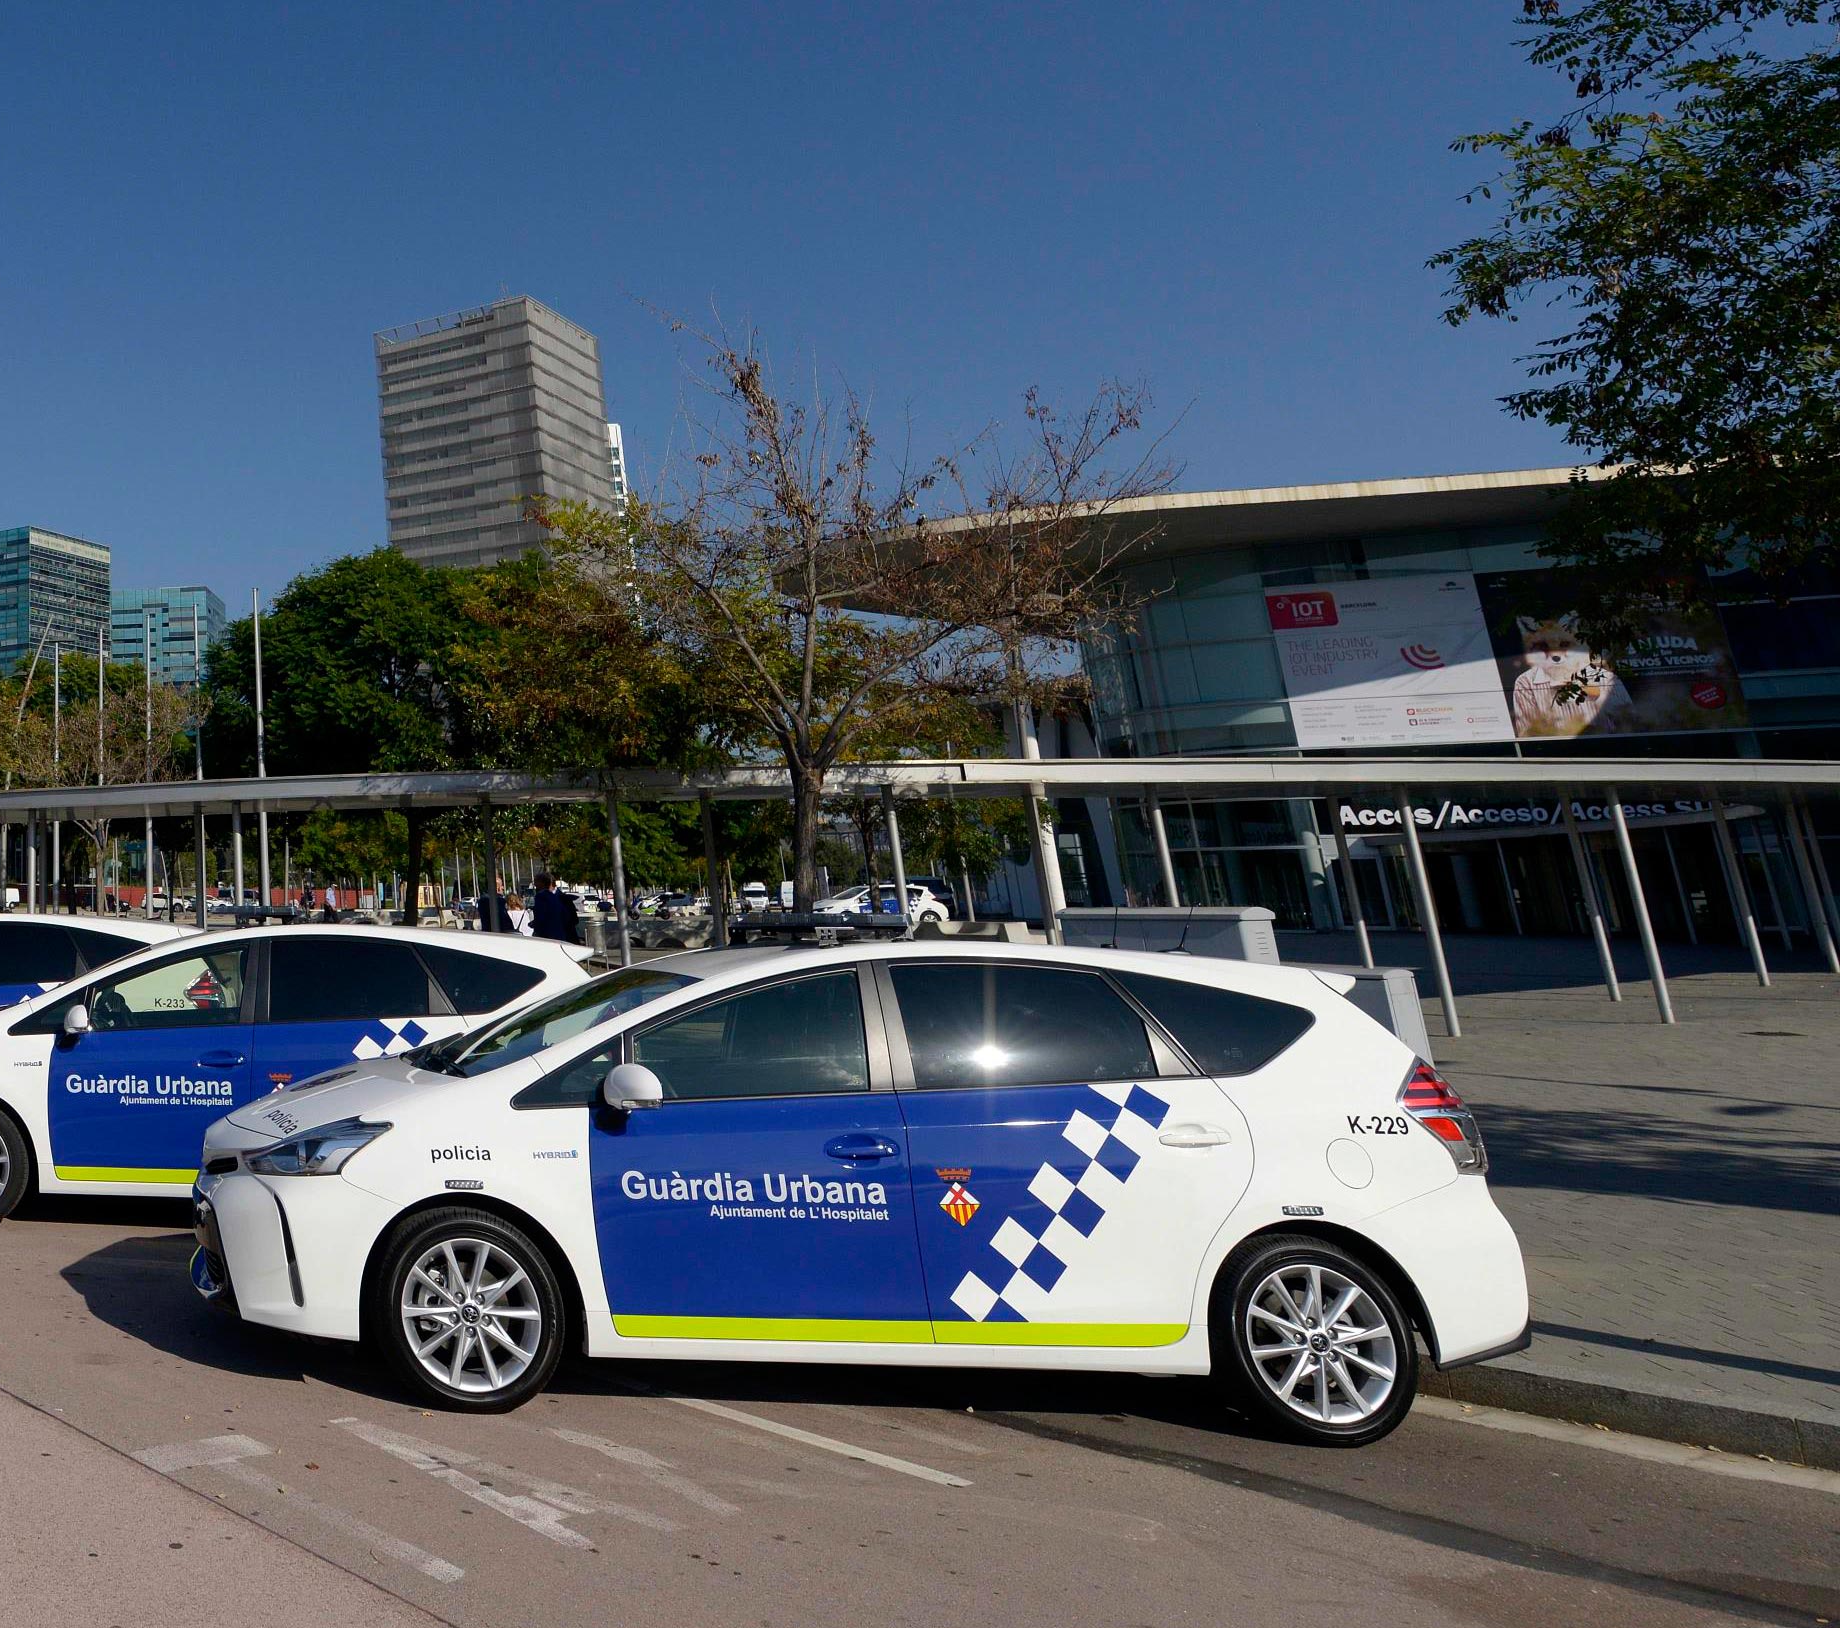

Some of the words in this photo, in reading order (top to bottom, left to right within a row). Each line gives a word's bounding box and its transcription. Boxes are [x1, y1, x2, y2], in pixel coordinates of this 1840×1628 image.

[1287, 640, 1313, 652] THE
[1316, 636, 1374, 650] LEADING
[1289, 653, 1309, 665] IOT
[1312, 650, 1379, 663] INDUSTRY
[1291, 663, 1335, 677] EVENT
[154, 998, 185, 1009] K-233
[66, 1074, 149, 1095] Guàrdia
[155, 1075, 233, 1096] Urbana
[120, 1096, 168, 1106] Ajuntament
[170, 1096, 180, 1106] de
[265, 1108, 299, 1135] policia
[1347, 1115, 1409, 1135] K-229
[431, 1145, 491, 1163] policia
[621, 1170, 754, 1202] Guàrdia
[764, 1173, 887, 1205] Urbana
[710, 1205, 786, 1220] Ajuntament
[790, 1206, 806, 1219] de
